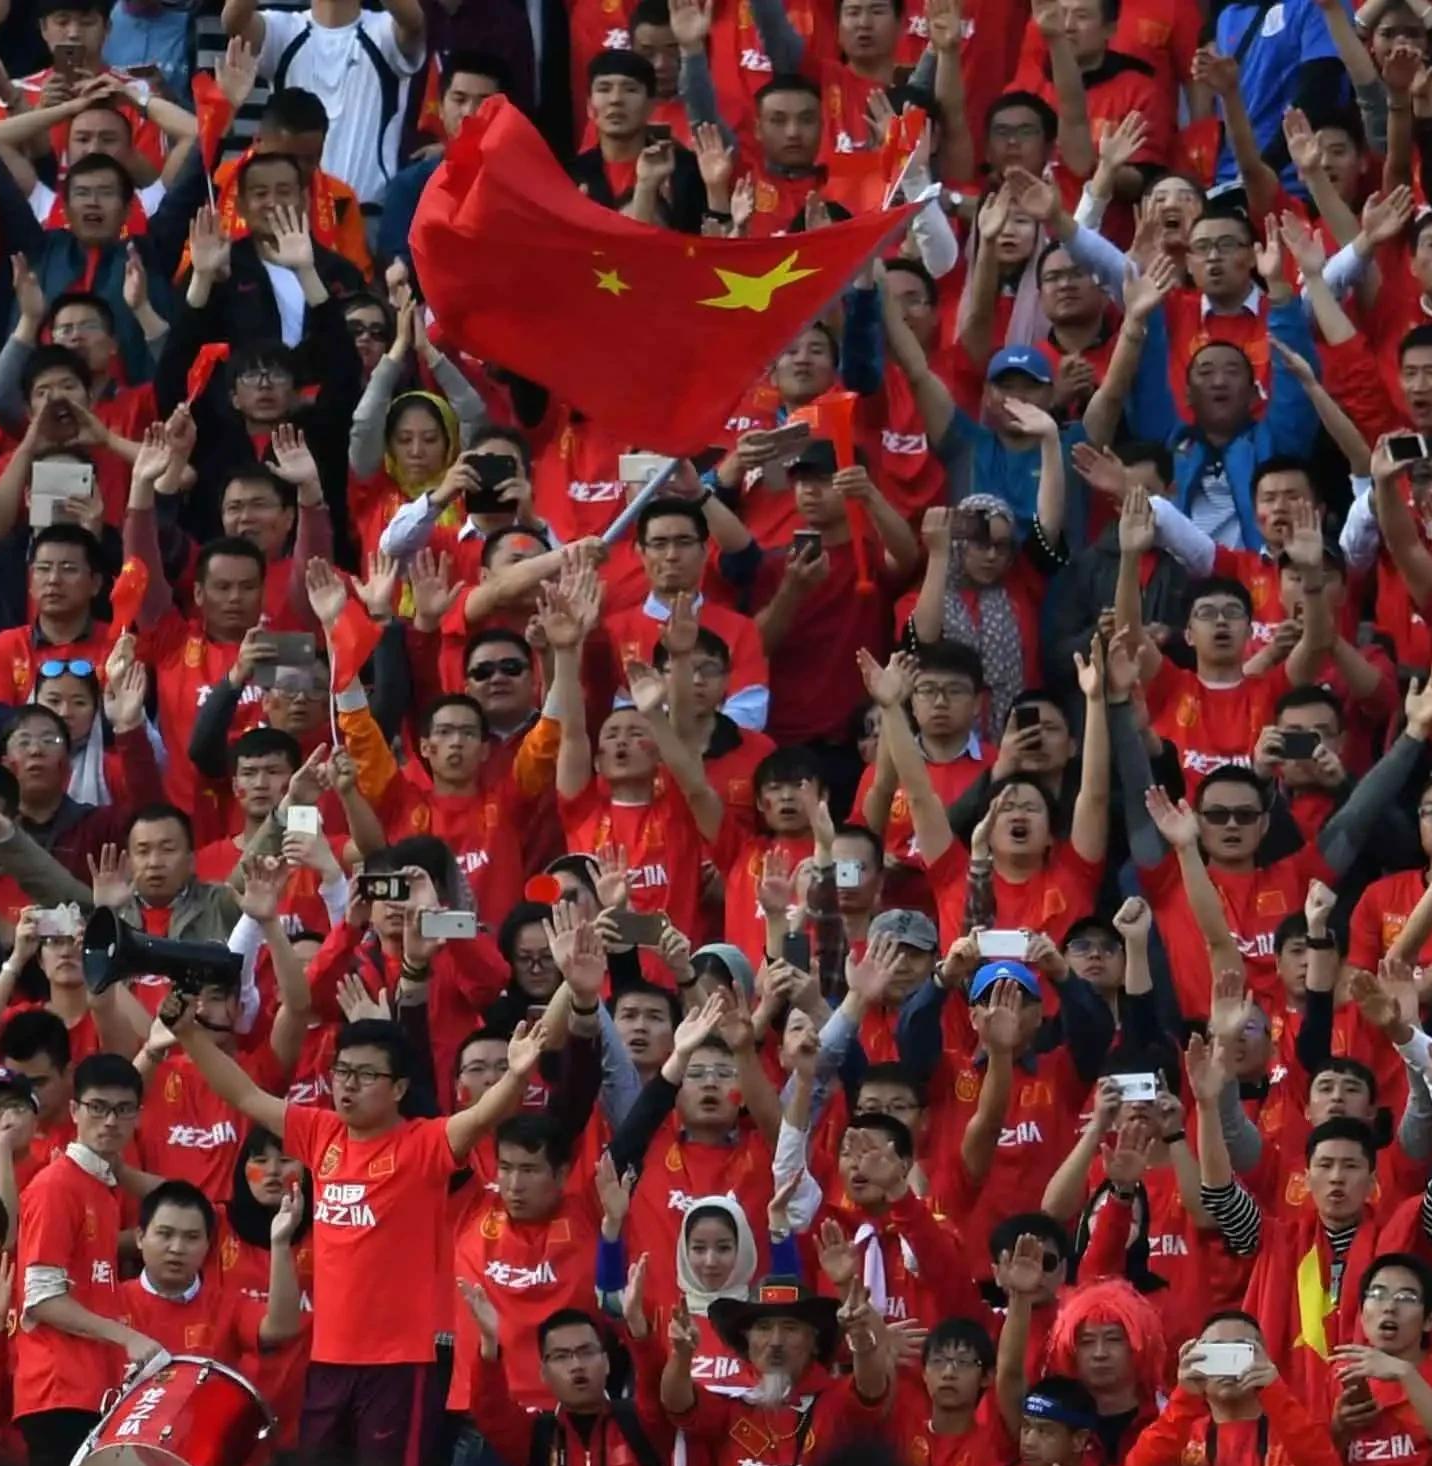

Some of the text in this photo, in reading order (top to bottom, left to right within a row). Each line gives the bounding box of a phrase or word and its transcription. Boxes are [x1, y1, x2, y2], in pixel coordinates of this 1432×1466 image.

[882, 430, 927, 455] 龙之
[568, 481, 626, 502] 龙之
[626, 864, 668, 887] 之队
[1231, 933, 1274, 957] 之队
[288, 1077, 332, 1104] 之队
[168, 1120, 238, 1148] 龙之队
[997, 1121, 1042, 1146] 之队
[323, 1182, 366, 1204] 中国
[314, 1200, 377, 1229] 龙之队
[1148, 1234, 1189, 1258] 之队
[483, 1260, 557, 1290] 龙之队
[689, 1355, 740, 1380] 之队
[1349, 1434, 1418, 1461] 龙之队
